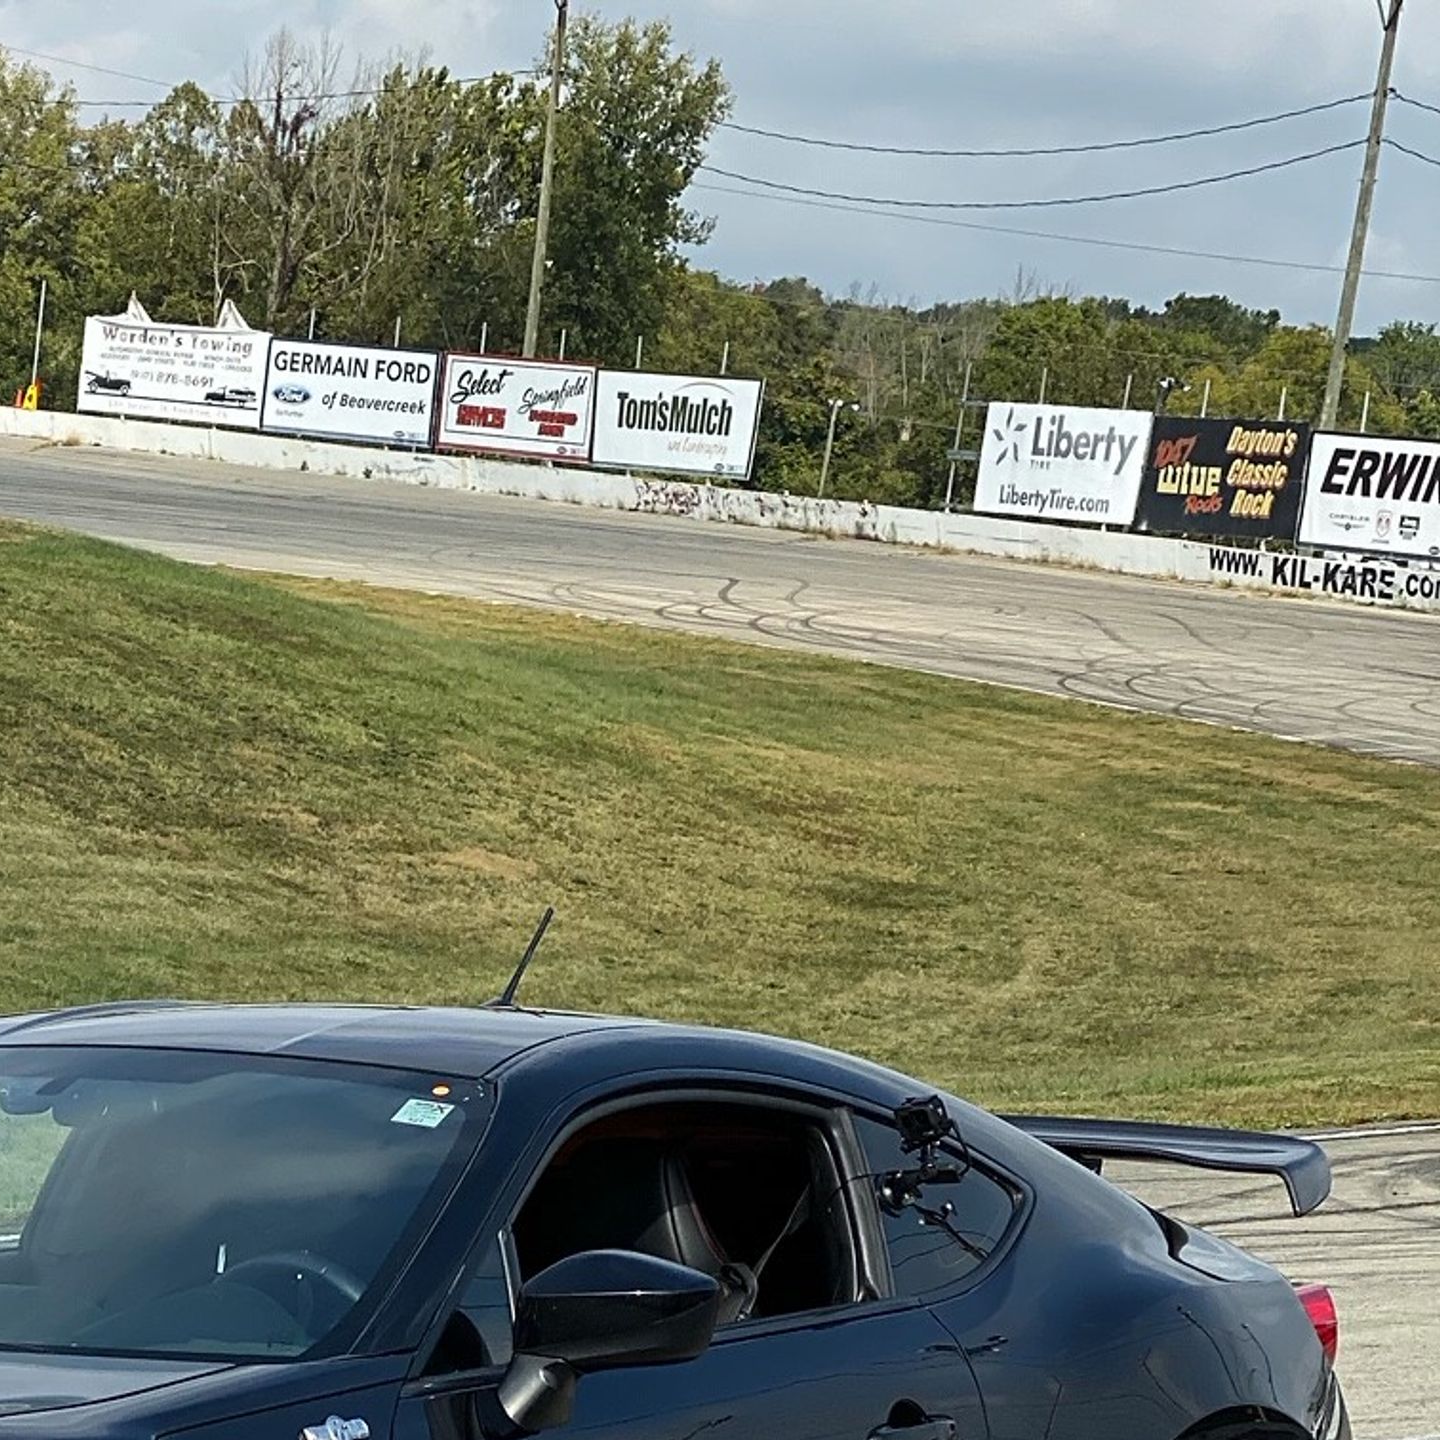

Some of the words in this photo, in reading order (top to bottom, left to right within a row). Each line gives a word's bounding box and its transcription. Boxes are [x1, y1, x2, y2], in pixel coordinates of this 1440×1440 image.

[191, 333, 253, 360] Towing
[273, 350, 369, 379] GERMAIN
[375, 359, 431, 384] FORD
[450, 369, 514, 404] Select
[321, 390, 338, 410] of
[339, 393, 427, 415] Beavercreek
[1031, 414, 1138, 476] Liberty
[1225, 426, 1299, 458] Dayton's
[1031, 459, 1051, 470] TIRE
[1226, 458, 1288, 489] Classic
[998, 484, 1110, 513] LibertyTire.com
[1229, 489, 1275, 519] Rock
